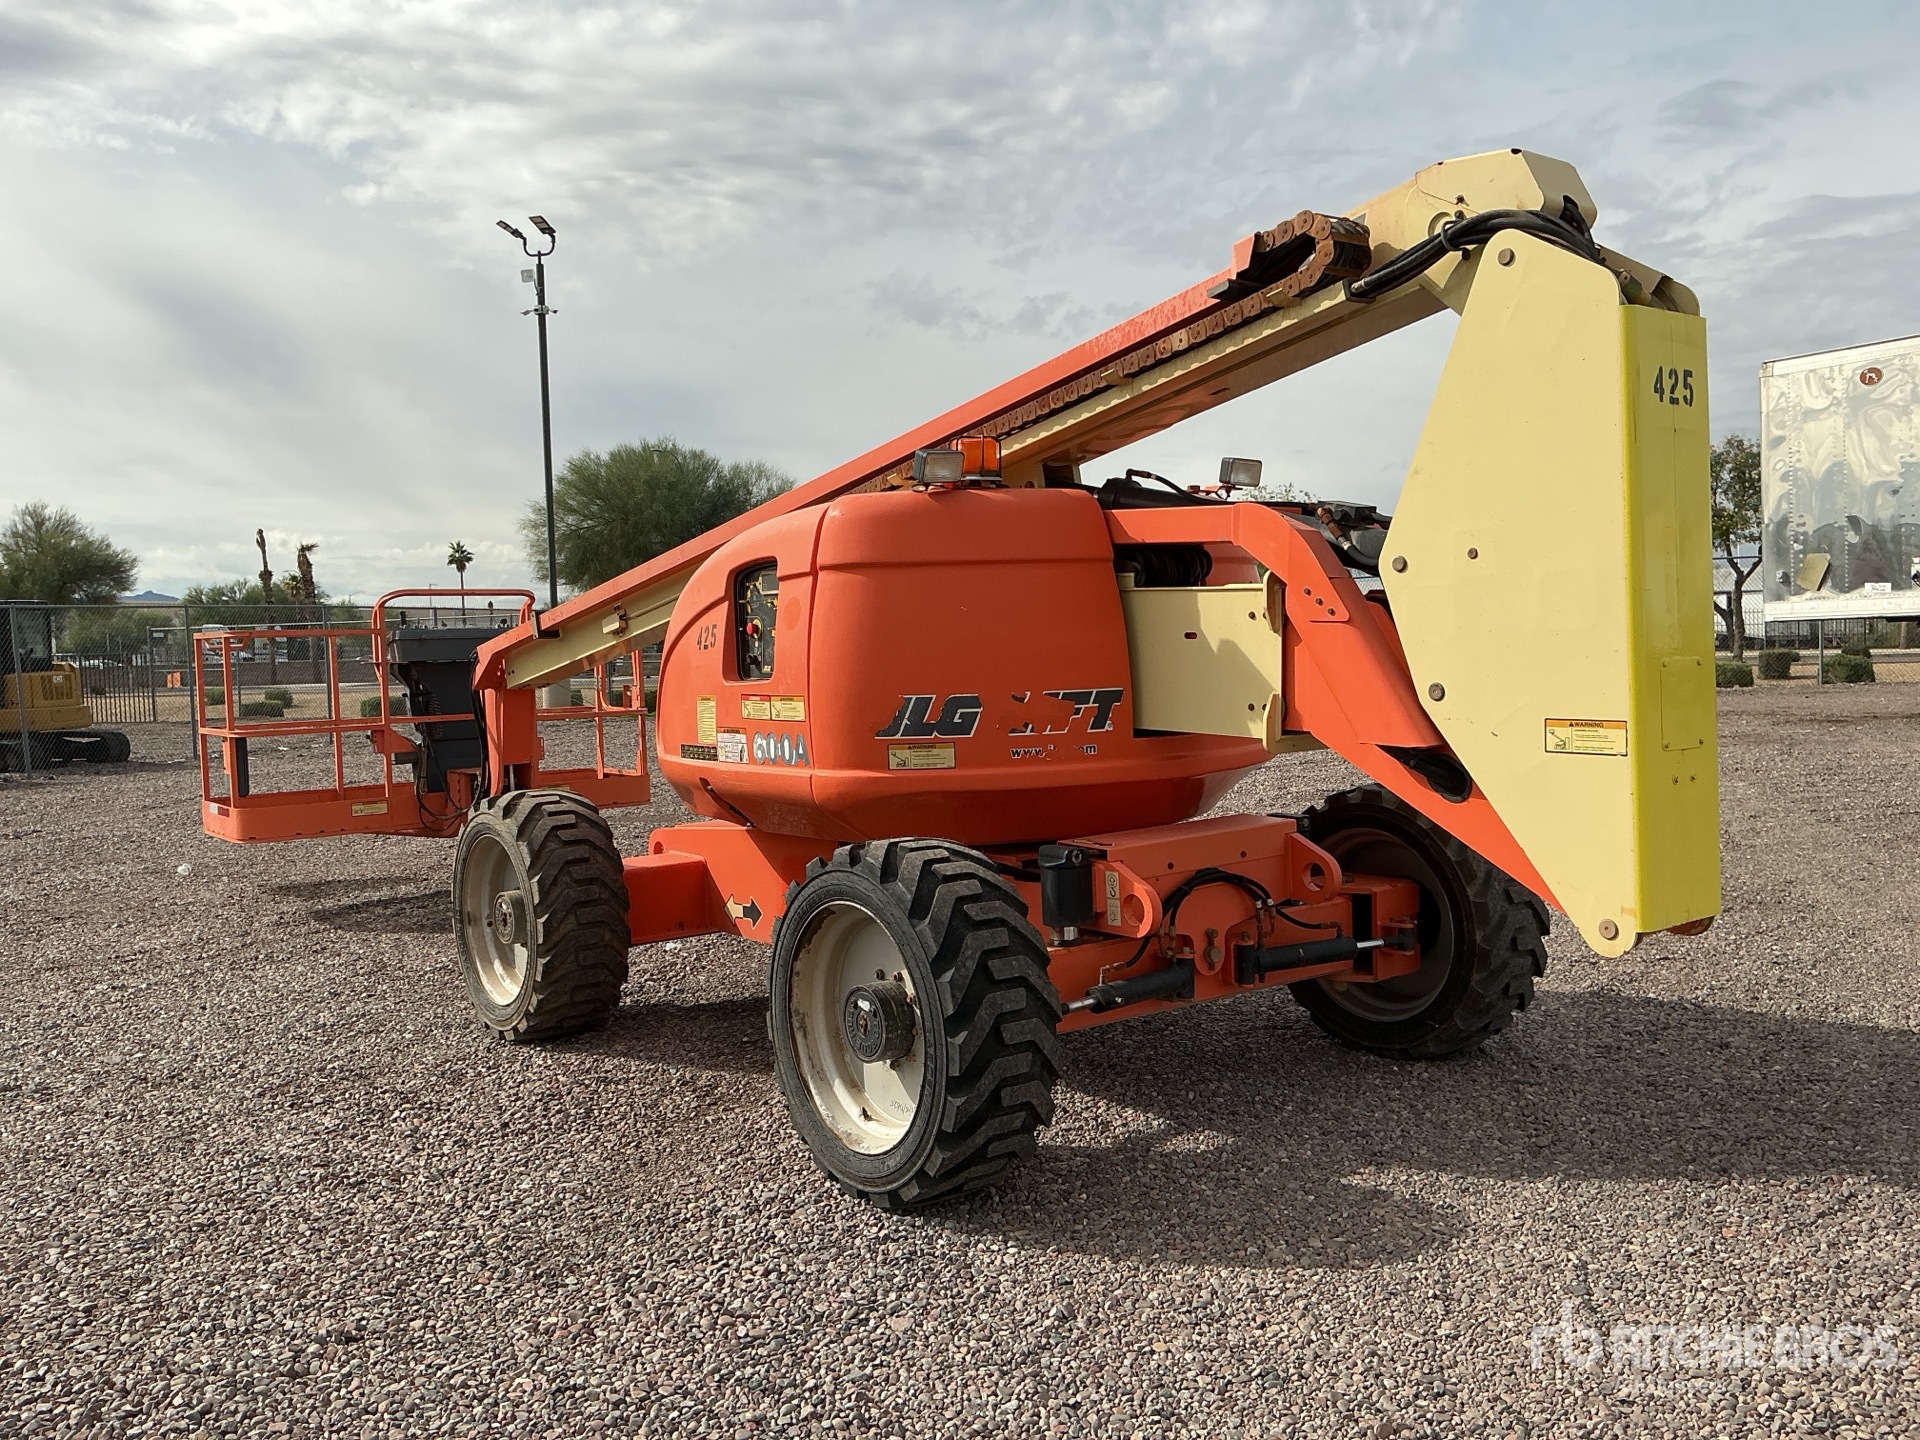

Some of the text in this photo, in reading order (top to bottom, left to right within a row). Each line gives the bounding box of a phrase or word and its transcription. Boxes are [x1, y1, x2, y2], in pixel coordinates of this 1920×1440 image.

[1653, 366, 1694, 408] 425
[696, 624, 718, 651] 425
[874, 694, 983, 740] JLG
[1573, 721, 1604, 729] WARNING
[752, 731, 810, 767] 600A
